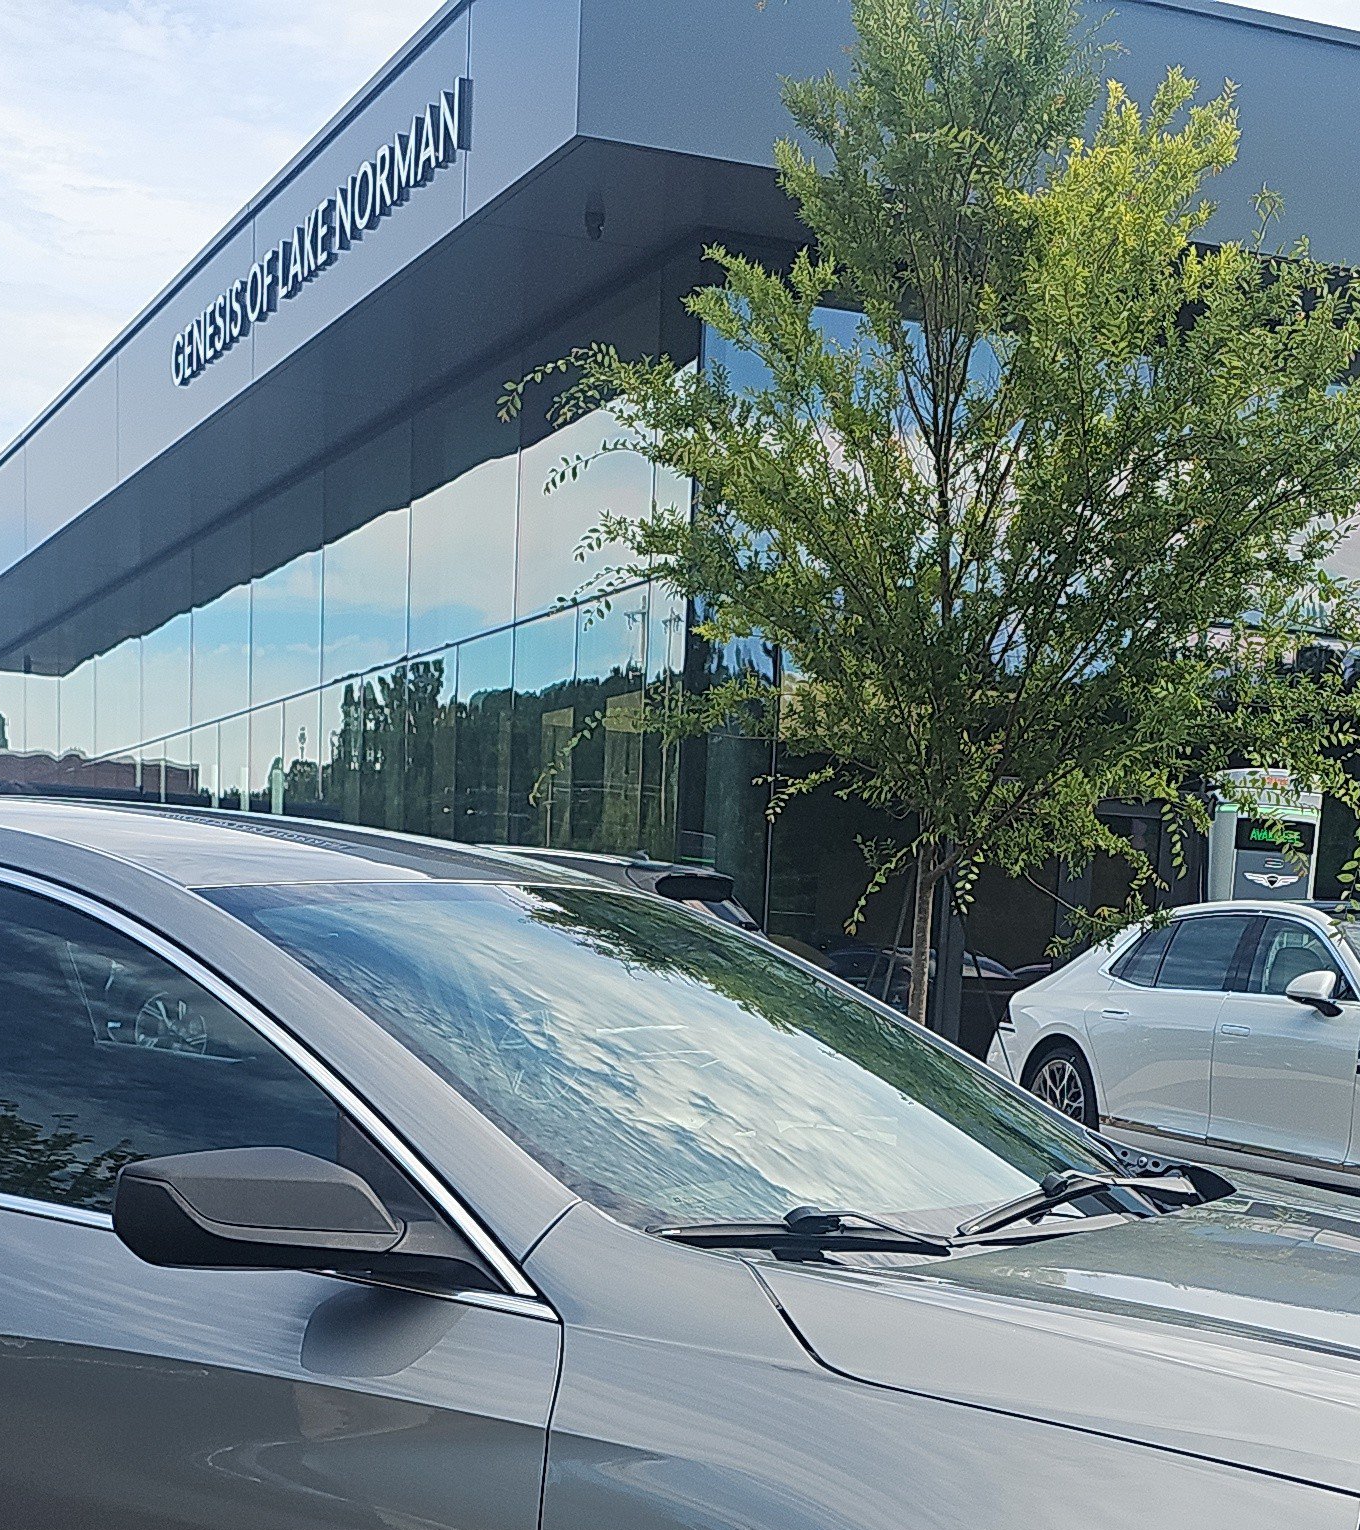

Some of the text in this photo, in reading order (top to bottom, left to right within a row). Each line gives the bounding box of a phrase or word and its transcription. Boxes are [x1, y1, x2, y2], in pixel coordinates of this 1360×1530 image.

[171, 76, 460, 387] GENESIS OF LAKE NORMAN
